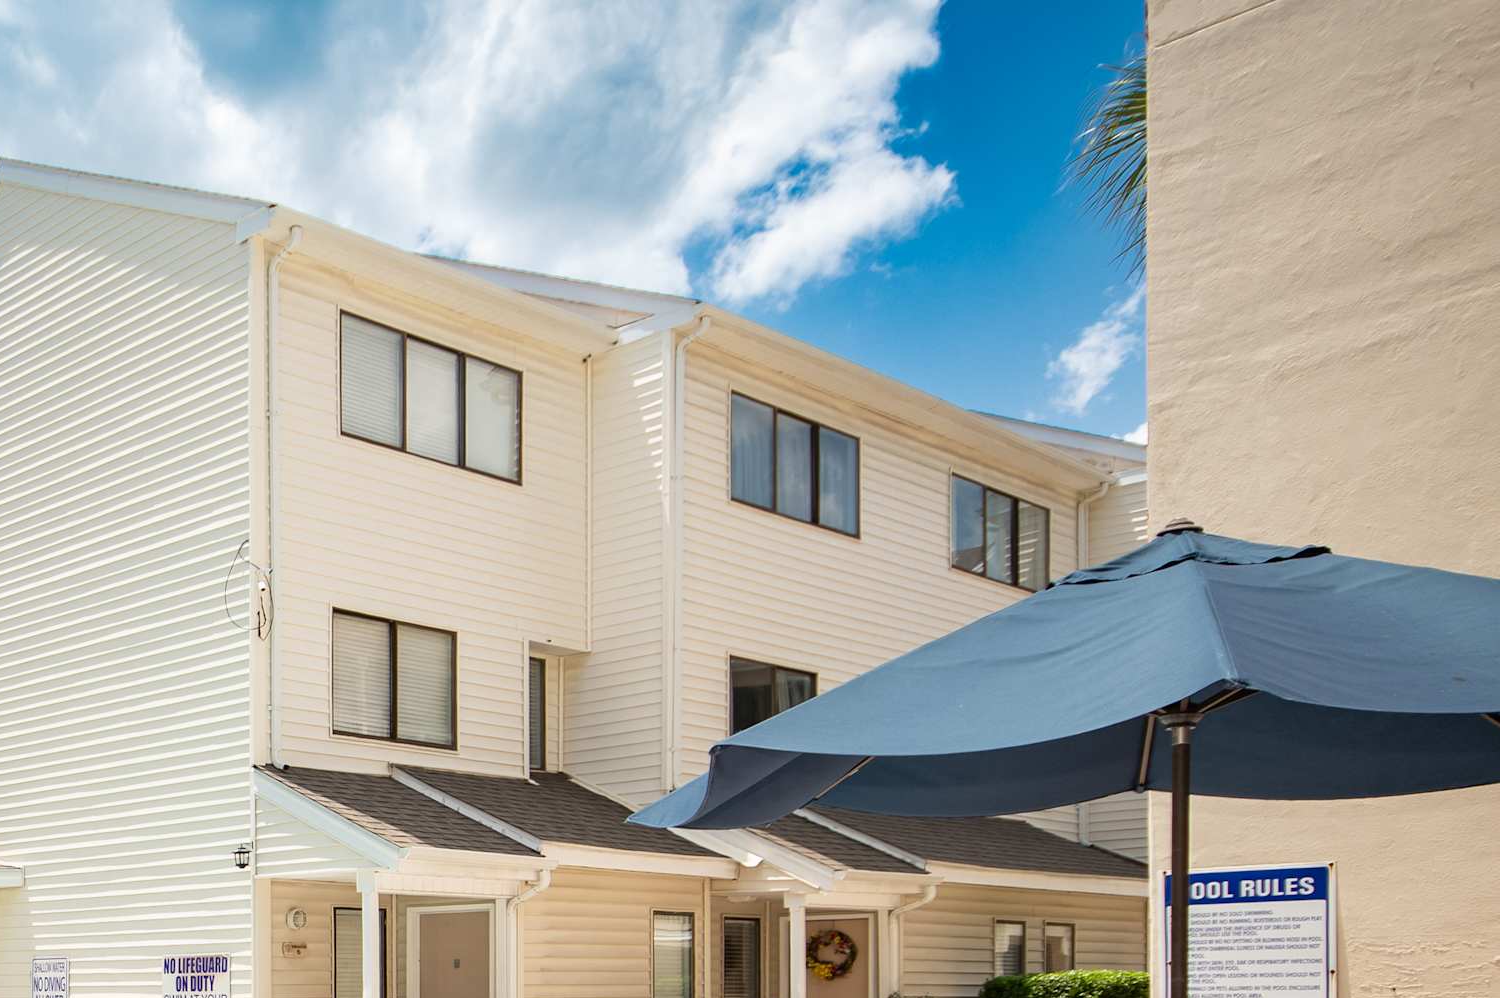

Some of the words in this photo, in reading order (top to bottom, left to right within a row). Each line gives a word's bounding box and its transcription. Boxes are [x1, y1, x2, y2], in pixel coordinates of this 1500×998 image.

[1190, 881, 1233, 900] OOL
[1240, 877, 1314, 897] RULES
[164, 958, 176, 974] NO
[178, 956, 228, 974] LIFEGUARD
[34, 976, 43, 992] NO
[44, 976, 65, 992] DIVING
[176, 976, 188, 992] ON
[190, 975, 214, 992] DUTY
